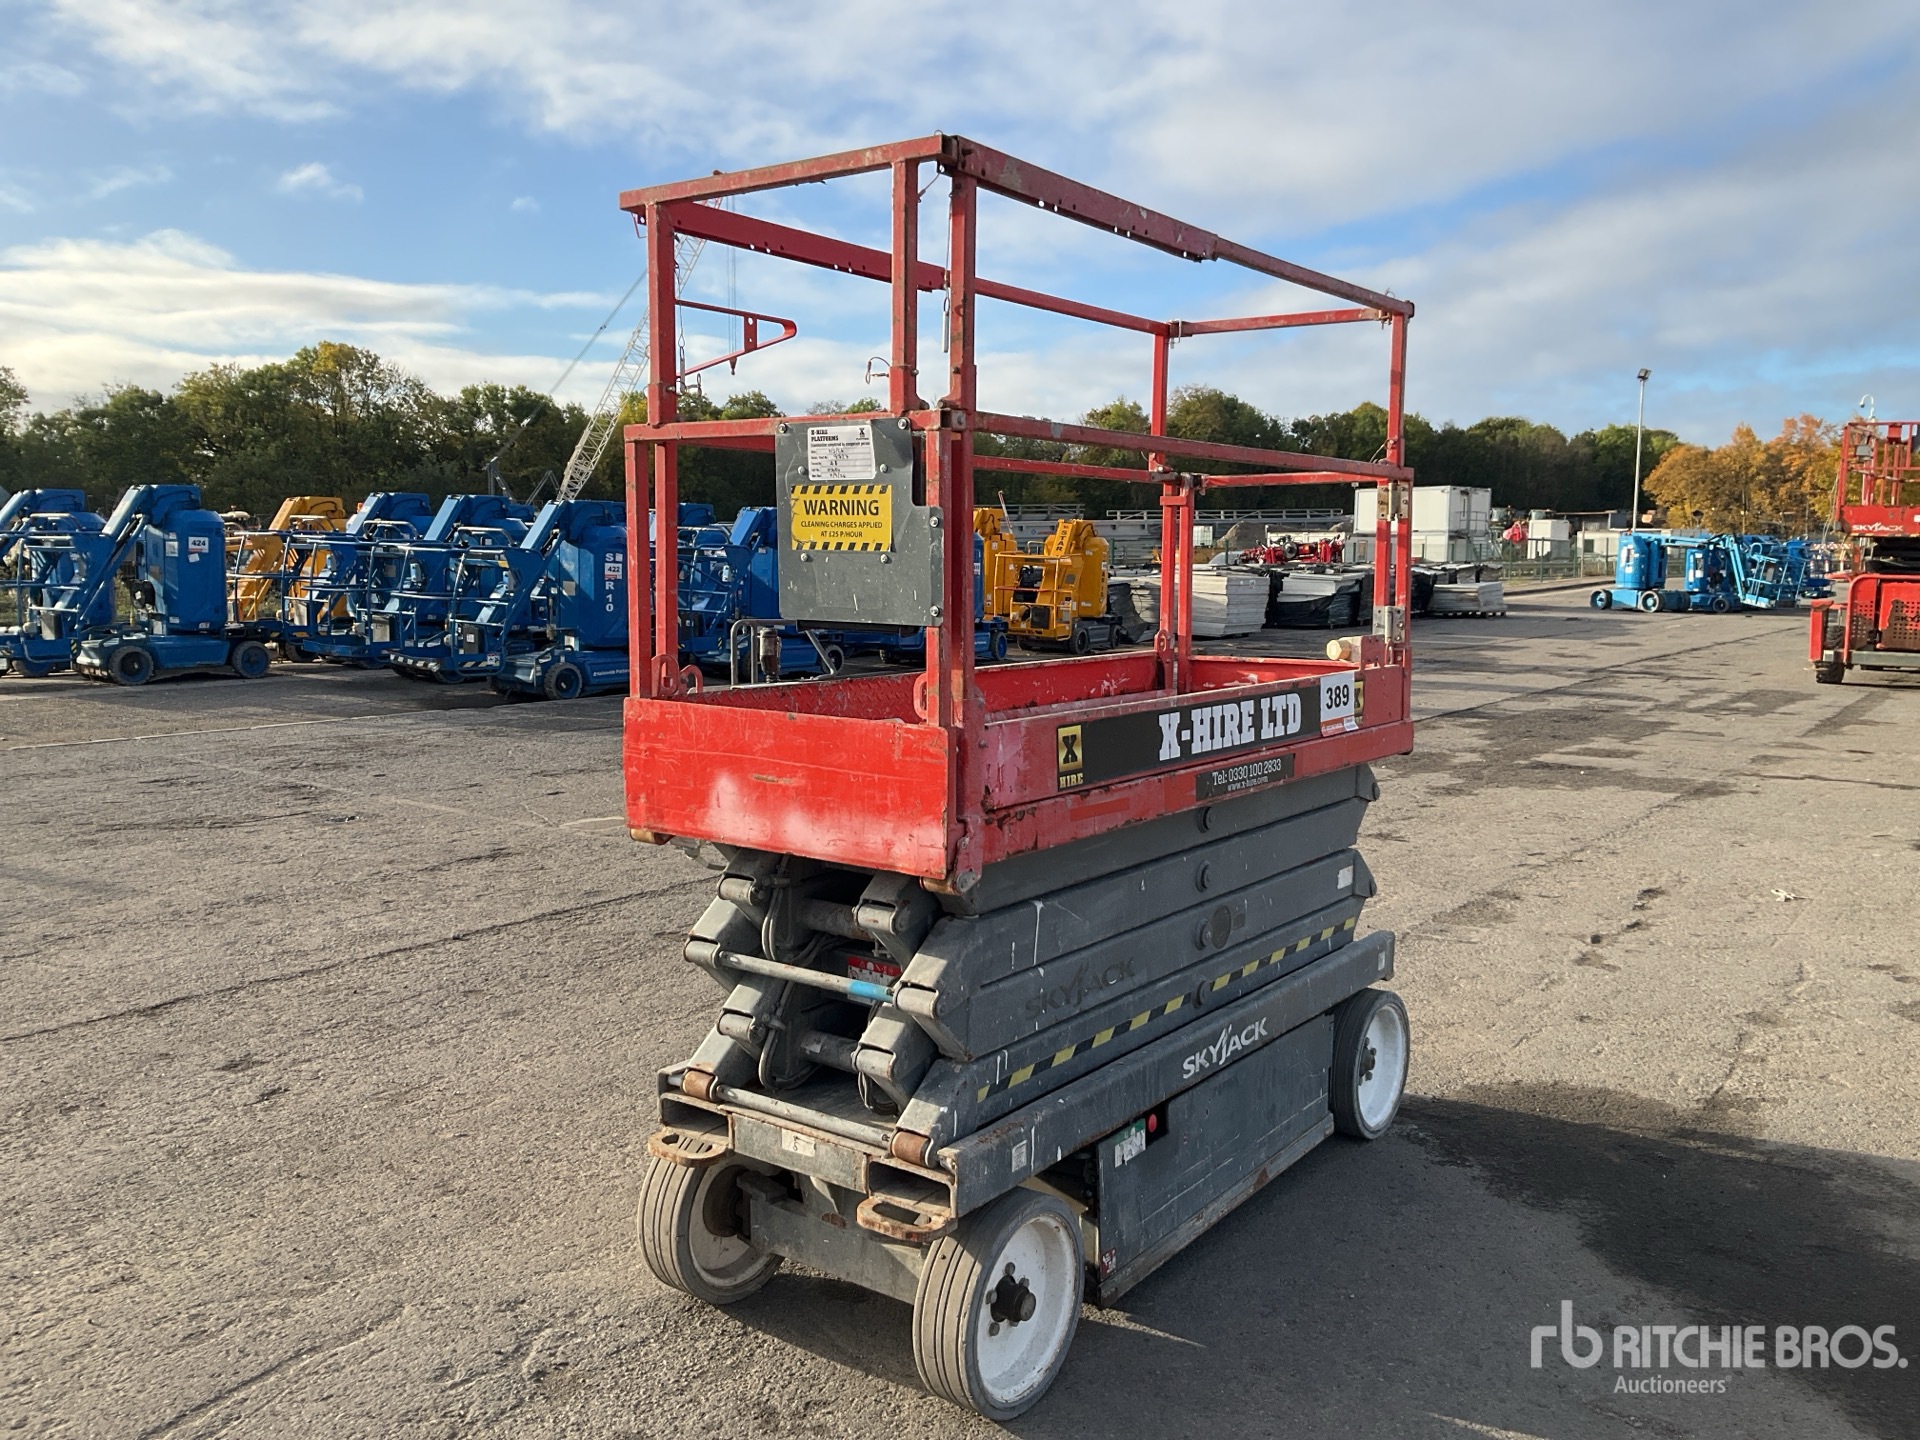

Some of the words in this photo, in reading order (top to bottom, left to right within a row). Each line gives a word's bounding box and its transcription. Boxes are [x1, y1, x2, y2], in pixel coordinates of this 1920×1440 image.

[803, 499, 880, 516] WARNING
[801, 520, 830, 528] CLEANING
[1852, 522, 1904, 531] SKYJACK
[1326, 684, 1350, 710] 389
[1159, 700, 1255, 761] X-HIRE
[1260, 693, 1302, 740] LTD
[1062, 734, 1077, 764] X
[1060, 773, 1083, 788] HIRE
[1212, 770, 1228, 786] Tel:
[1228, 765, 1248, 782] 0330
[1249, 762, 1263, 777] 100
[1263, 758, 1282, 774] 2833
[1182, 1017, 1268, 1079] SKYJACK
